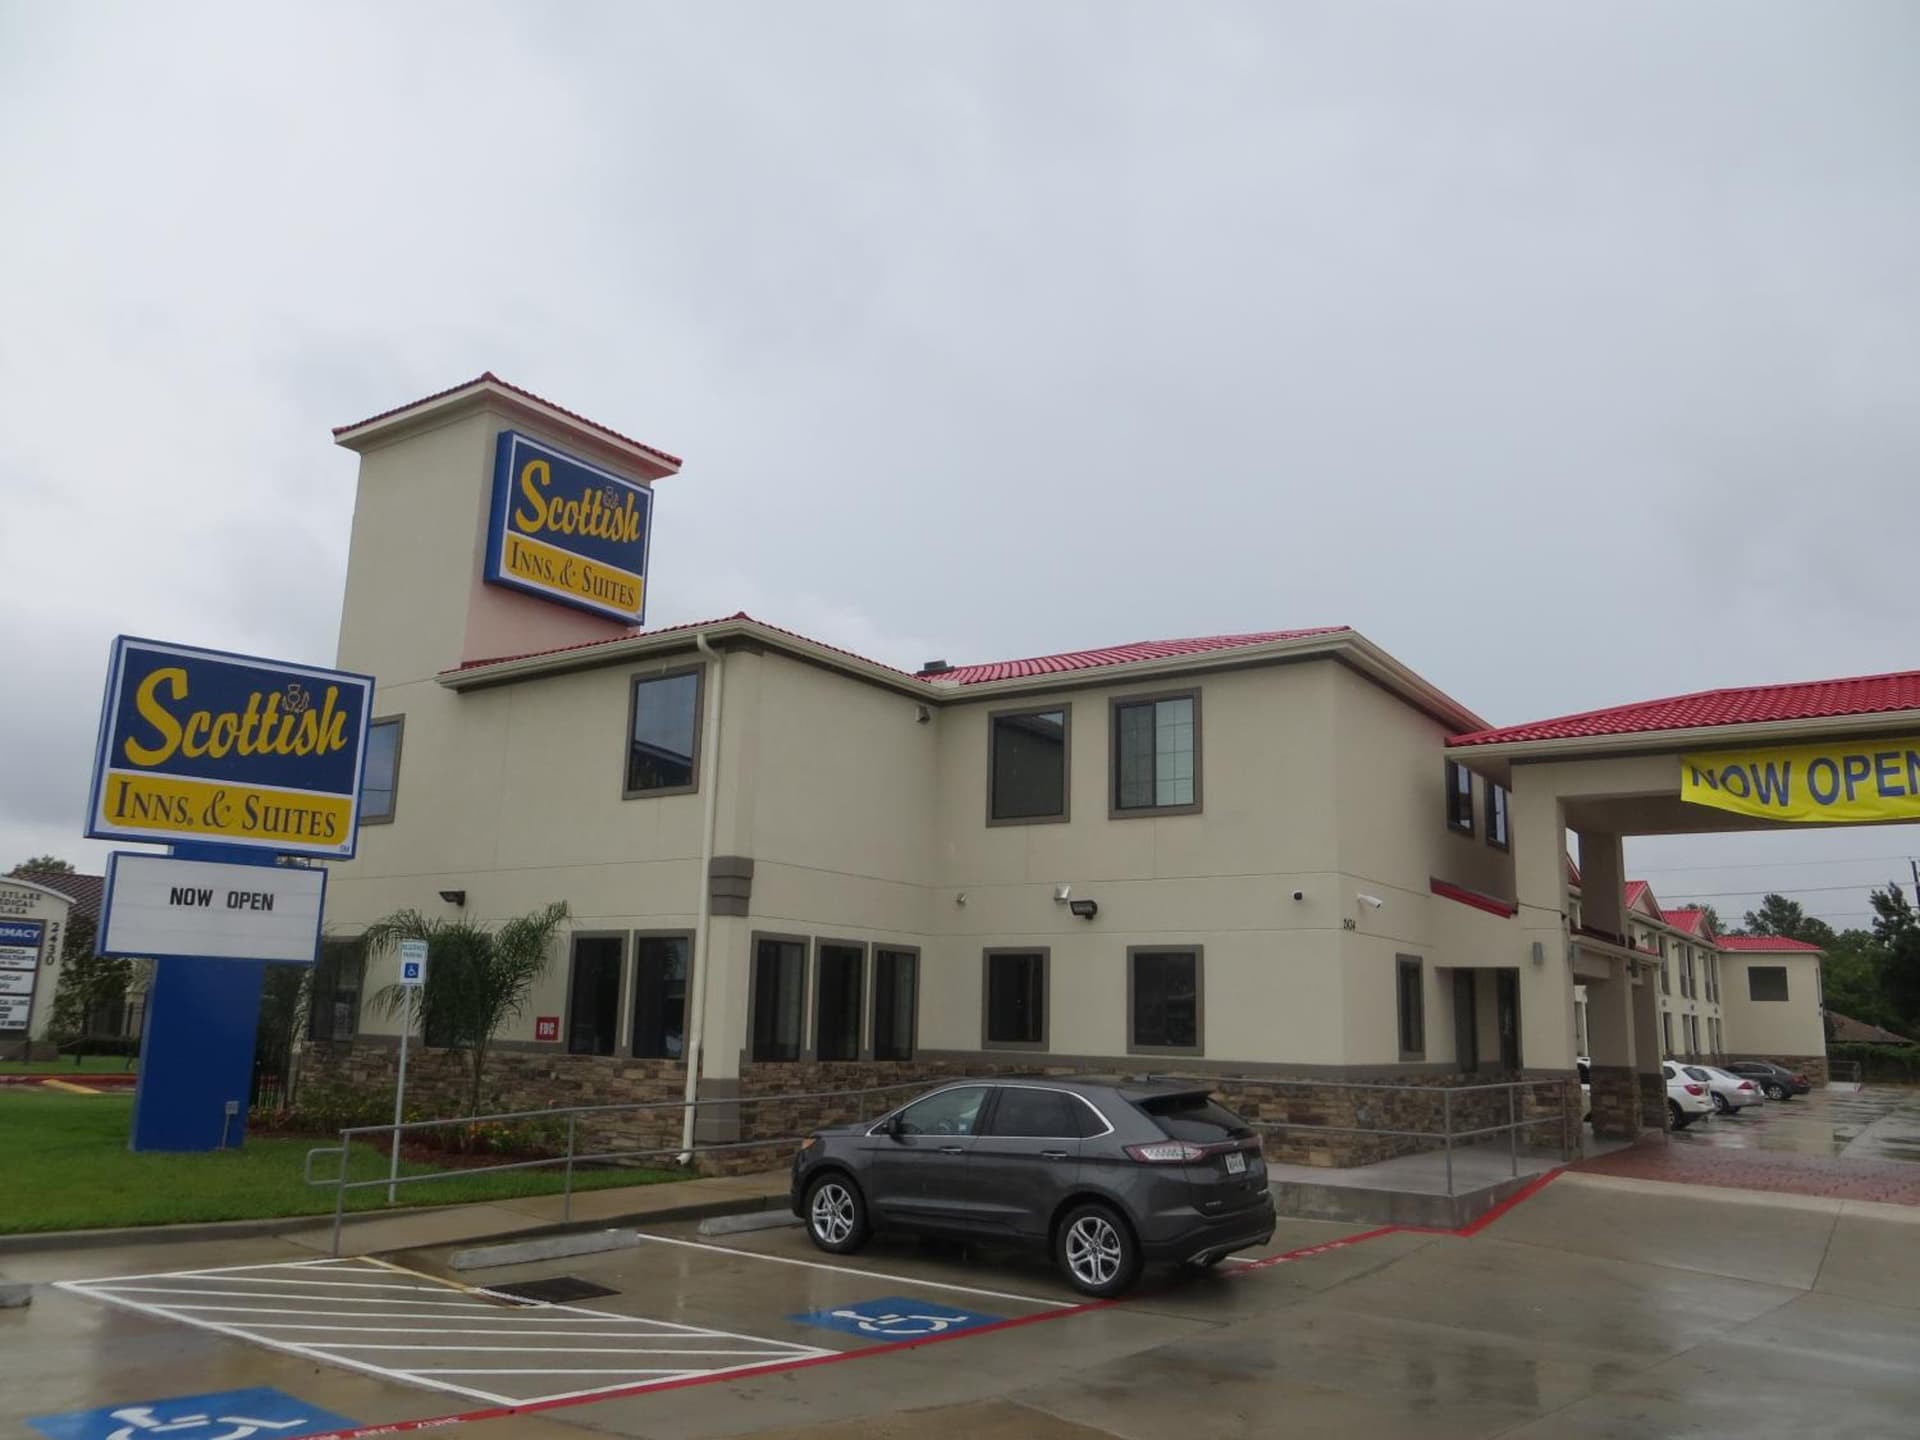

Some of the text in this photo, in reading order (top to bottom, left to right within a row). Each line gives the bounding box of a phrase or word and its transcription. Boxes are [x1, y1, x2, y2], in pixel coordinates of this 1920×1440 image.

[515, 459, 640, 543] Scottish
[560, 559, 576, 588] &
[582, 565, 634, 607] SUITES
[124, 667, 348, 767] Scottish
[1690, 761, 1791, 807] NOW
[202, 790, 232, 828] &
[242, 794, 337, 839] SUITES
[169, 887, 275, 911] NOW OPEN
